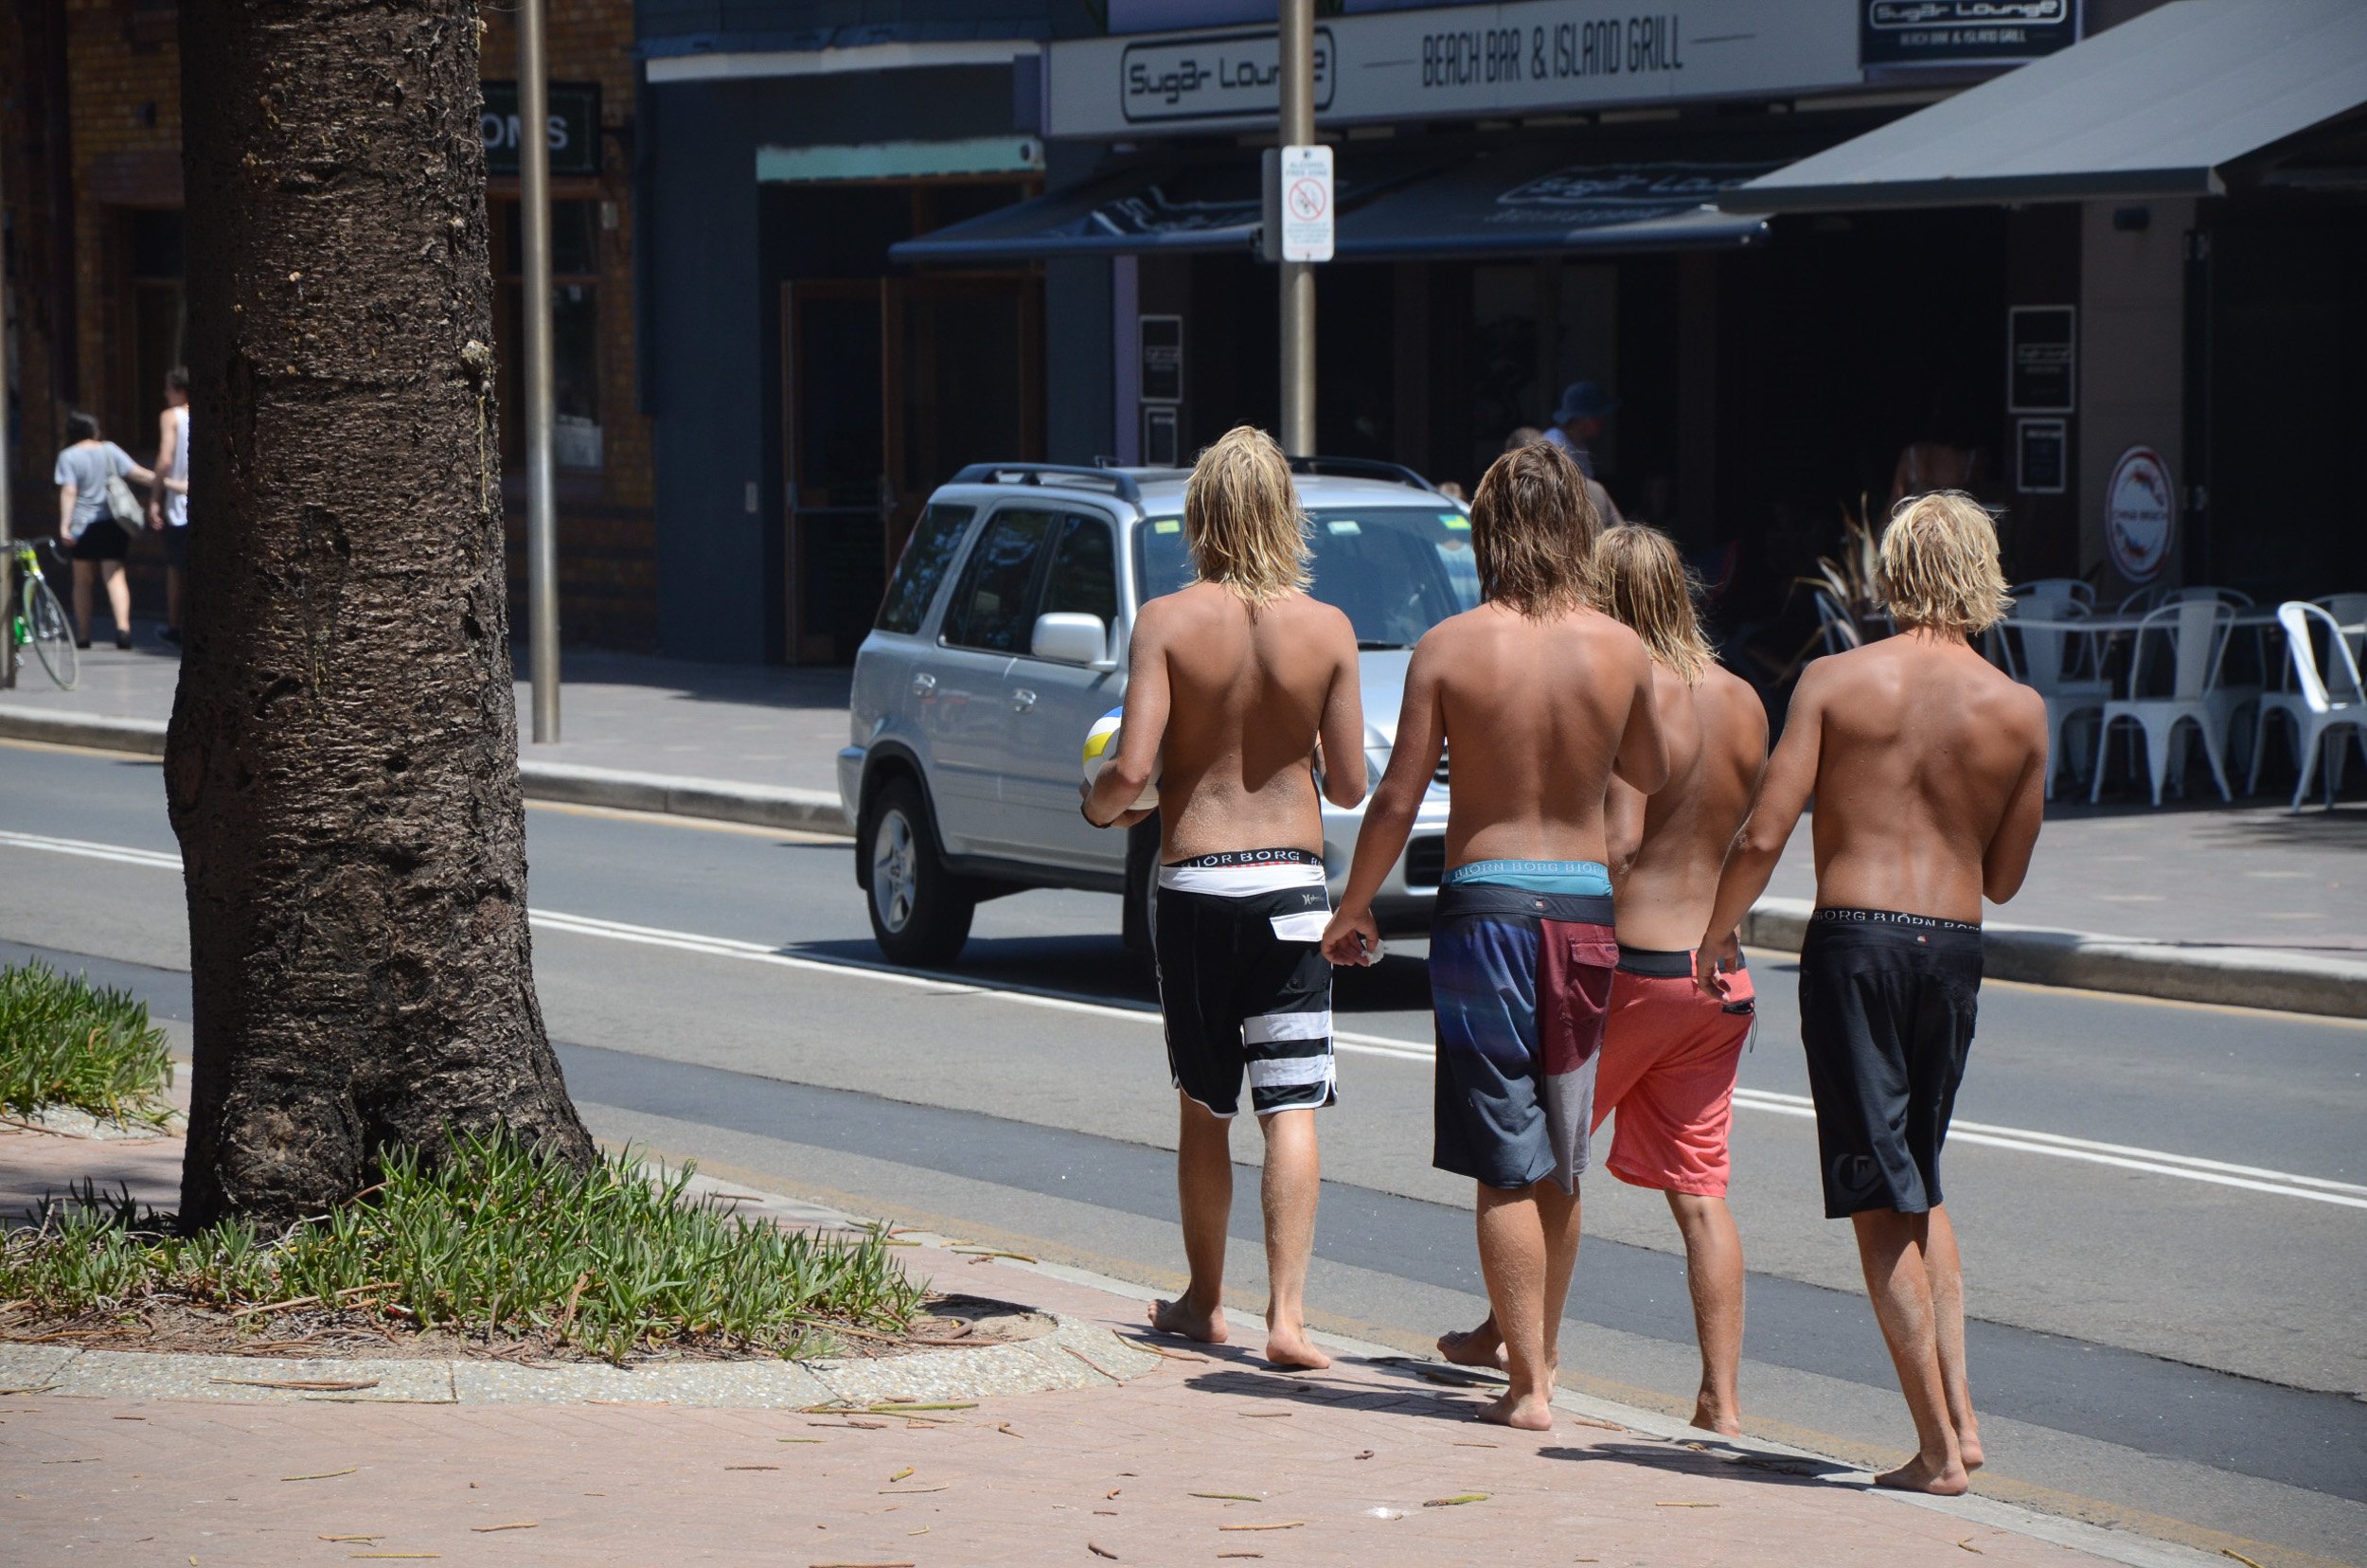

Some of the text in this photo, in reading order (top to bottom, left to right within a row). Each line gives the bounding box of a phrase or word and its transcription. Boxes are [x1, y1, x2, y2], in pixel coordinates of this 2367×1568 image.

[1956, 0, 2057, 18] Lounge
[1423, 14, 1683, 87] BEACH BAR & ISLAND GRILL
[1129, 59, 1212, 104] Sugar
[1240, 851, 1299, 862] BORG
[1512, 862, 1559, 872] BORG
